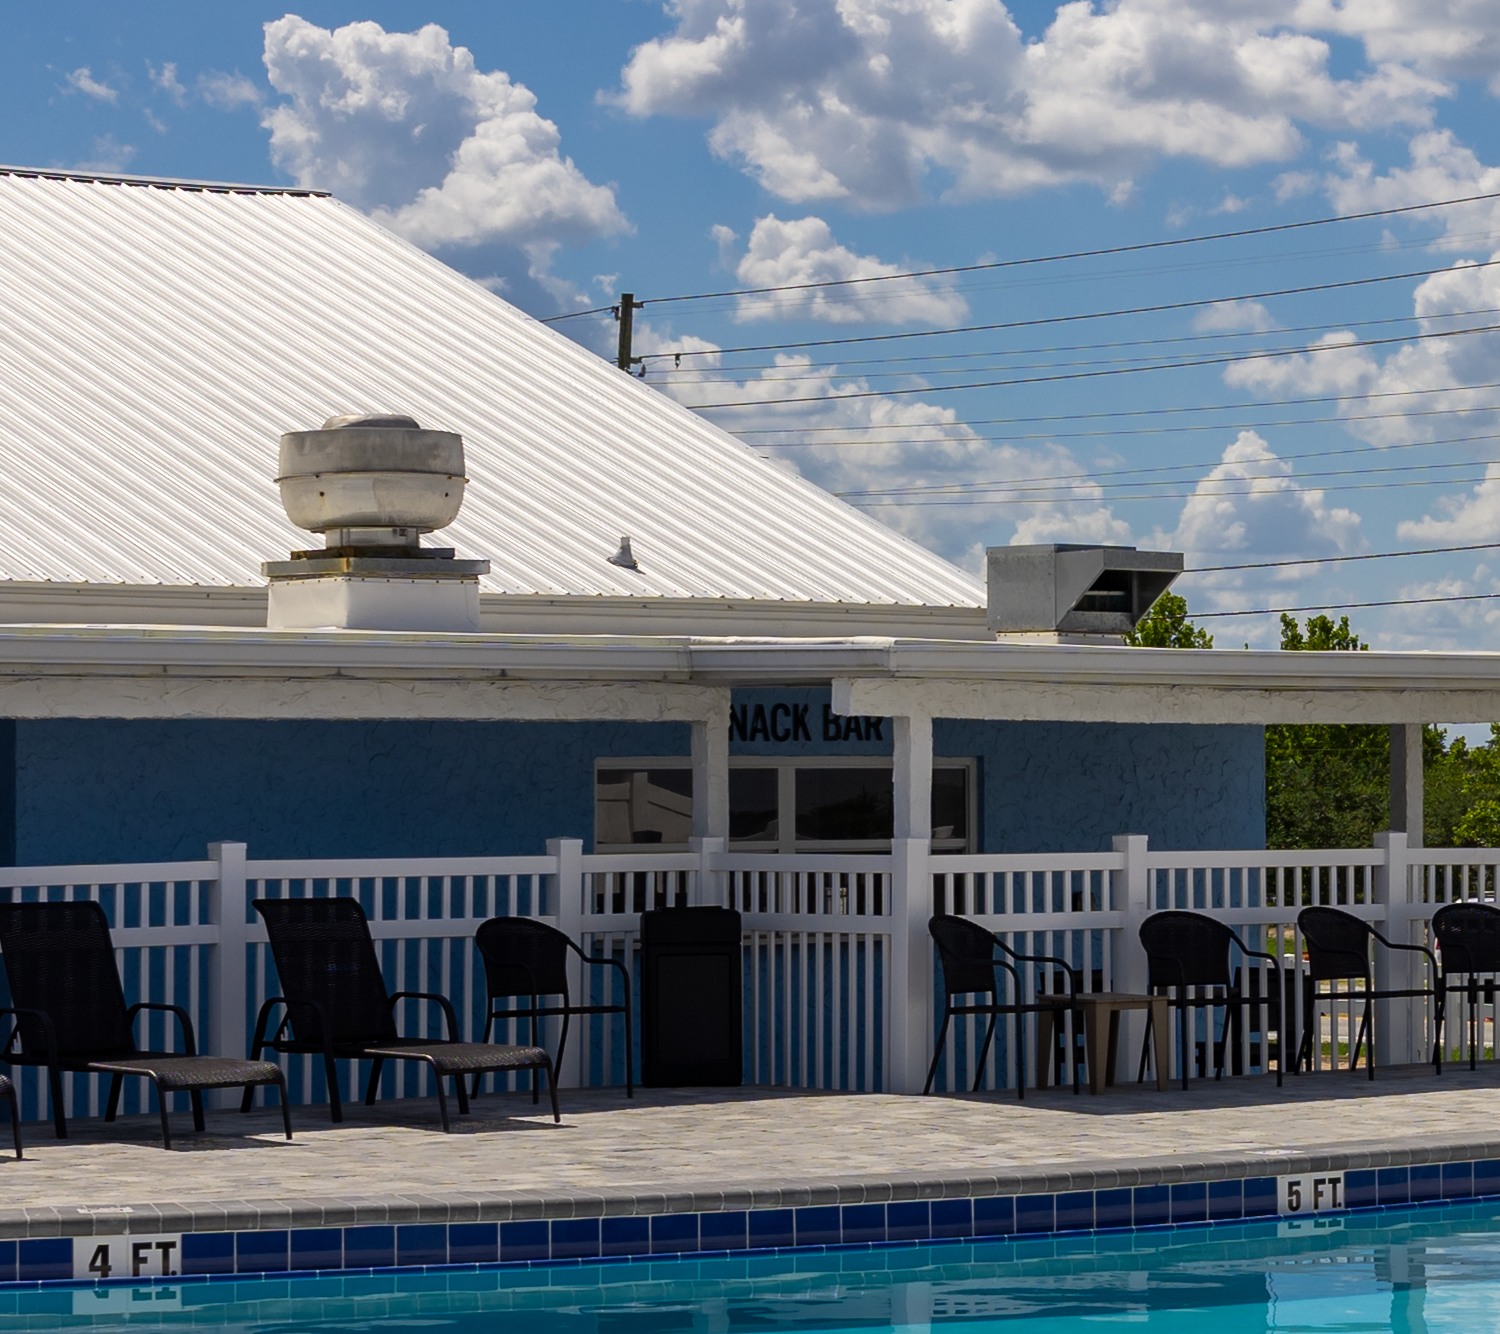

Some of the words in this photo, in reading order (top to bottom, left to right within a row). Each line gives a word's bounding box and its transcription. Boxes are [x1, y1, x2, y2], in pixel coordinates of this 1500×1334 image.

[729, 703, 812, 742] NACK
[822, 703, 883, 741] BAR
[1287, 1180, 1301, 1212] 5
[1313, 1177, 1342, 1210] FT.
[88, 1244, 112, 1278] 4
[132, 1241, 177, 1277] FT.
